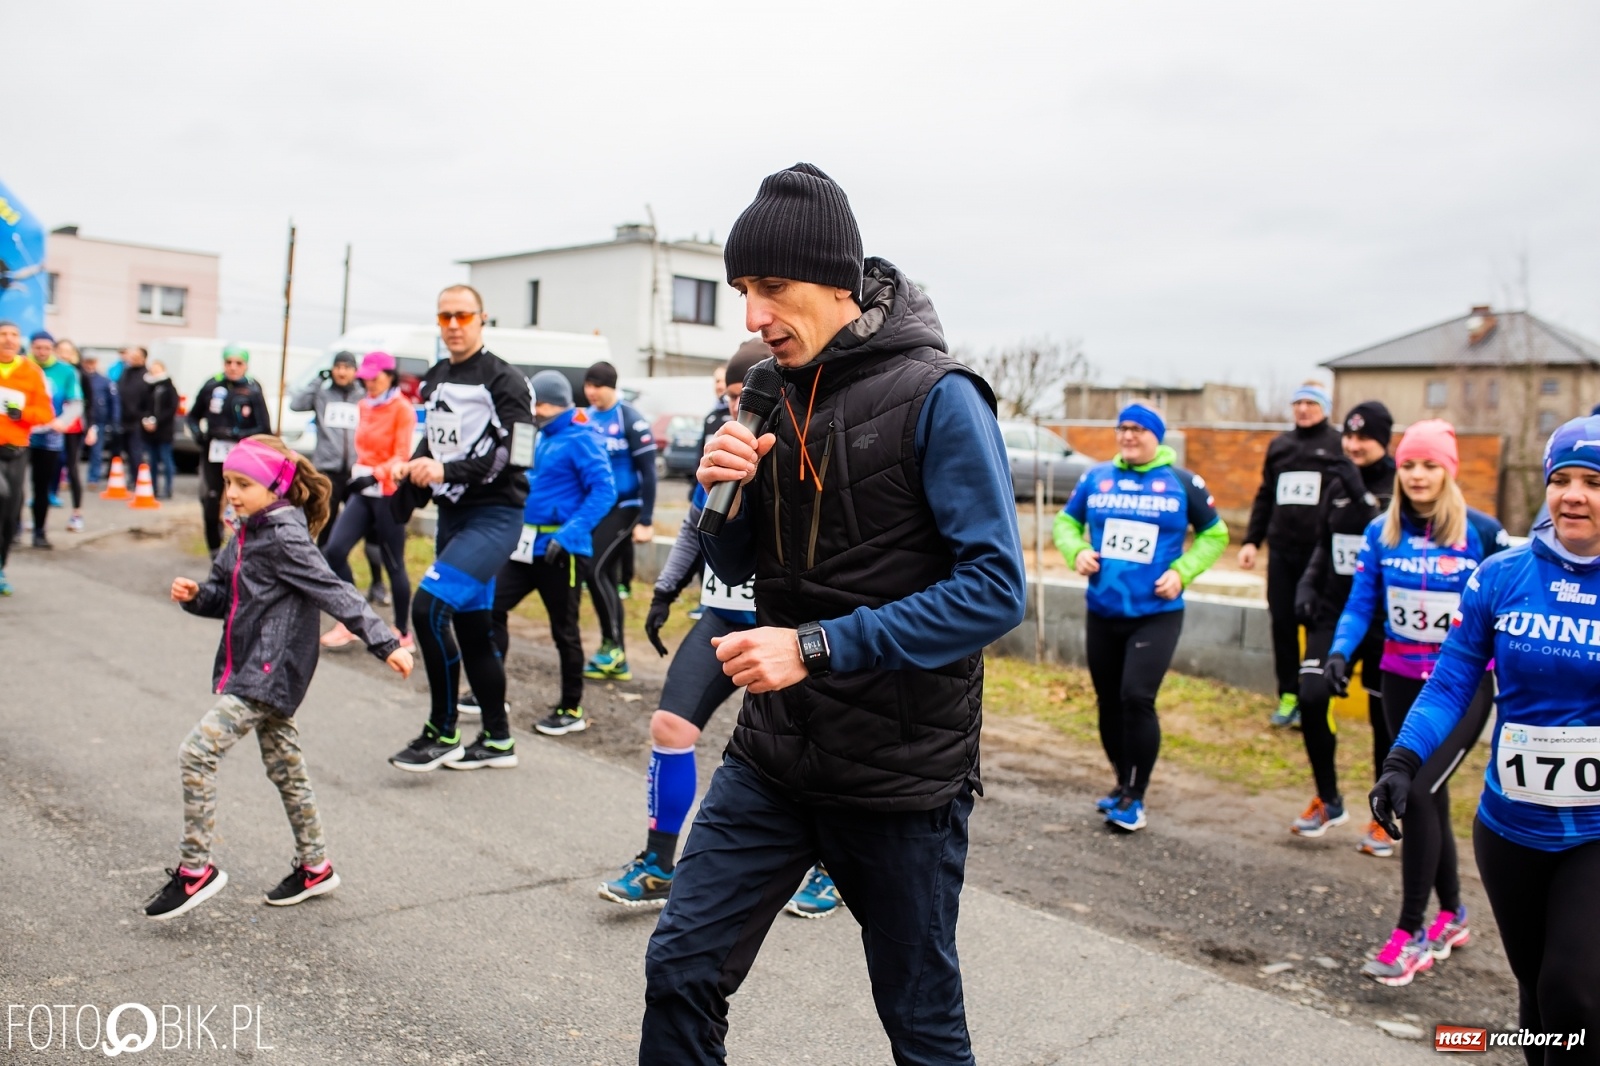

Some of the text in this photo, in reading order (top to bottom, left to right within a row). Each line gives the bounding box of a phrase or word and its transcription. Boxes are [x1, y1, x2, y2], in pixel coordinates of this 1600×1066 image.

[852, 433, 879, 450] 4F
[1106, 534, 1150, 555] 452
[1393, 605, 1451, 633] 334
[1506, 753, 1600, 793] 170
